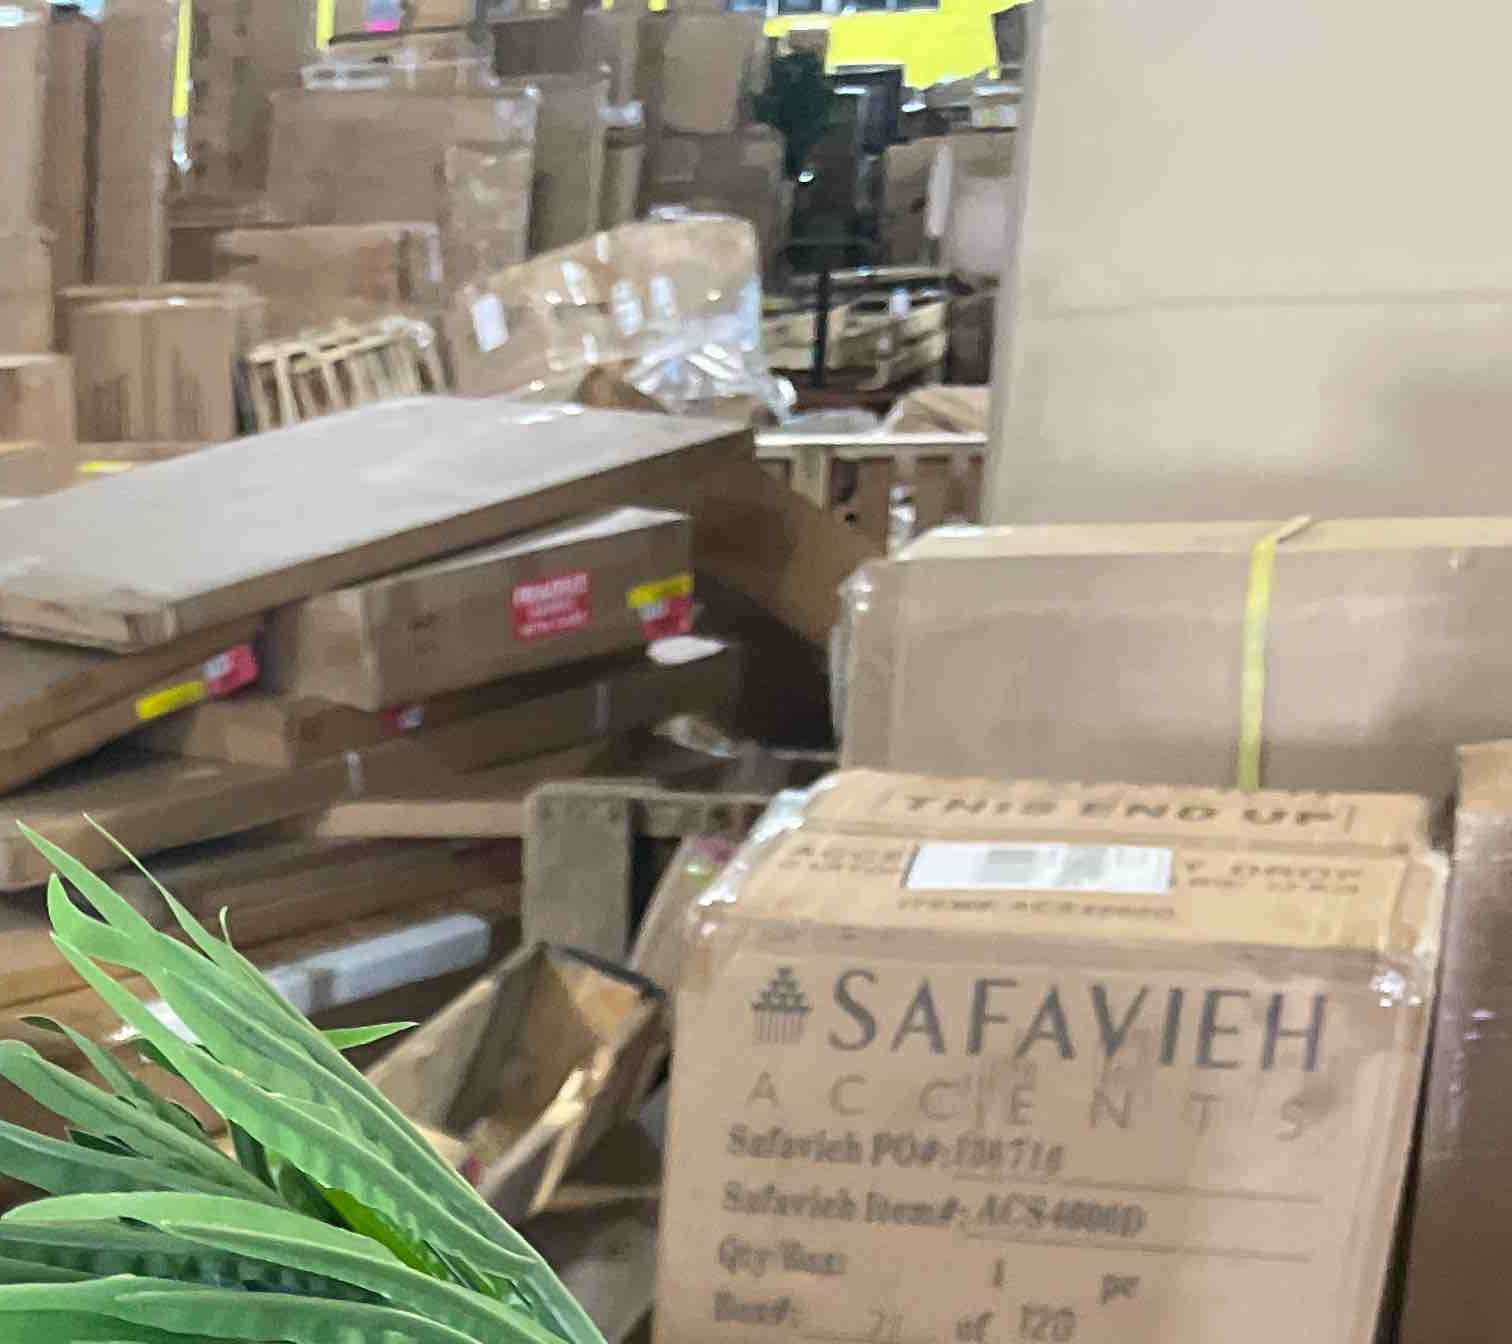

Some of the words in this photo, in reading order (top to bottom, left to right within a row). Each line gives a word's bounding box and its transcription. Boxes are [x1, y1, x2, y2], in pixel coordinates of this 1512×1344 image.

[1242, 805, 1336, 826] UP
[827, 968, 1328, 1073] SAFAVIEH
[745, 1069, 1306, 1142] ACCENTS
[726, 1123, 862, 1165] Safavieh
[722, 1180, 856, 1222] Safavieh
[955, 1310, 993, 1344] of
